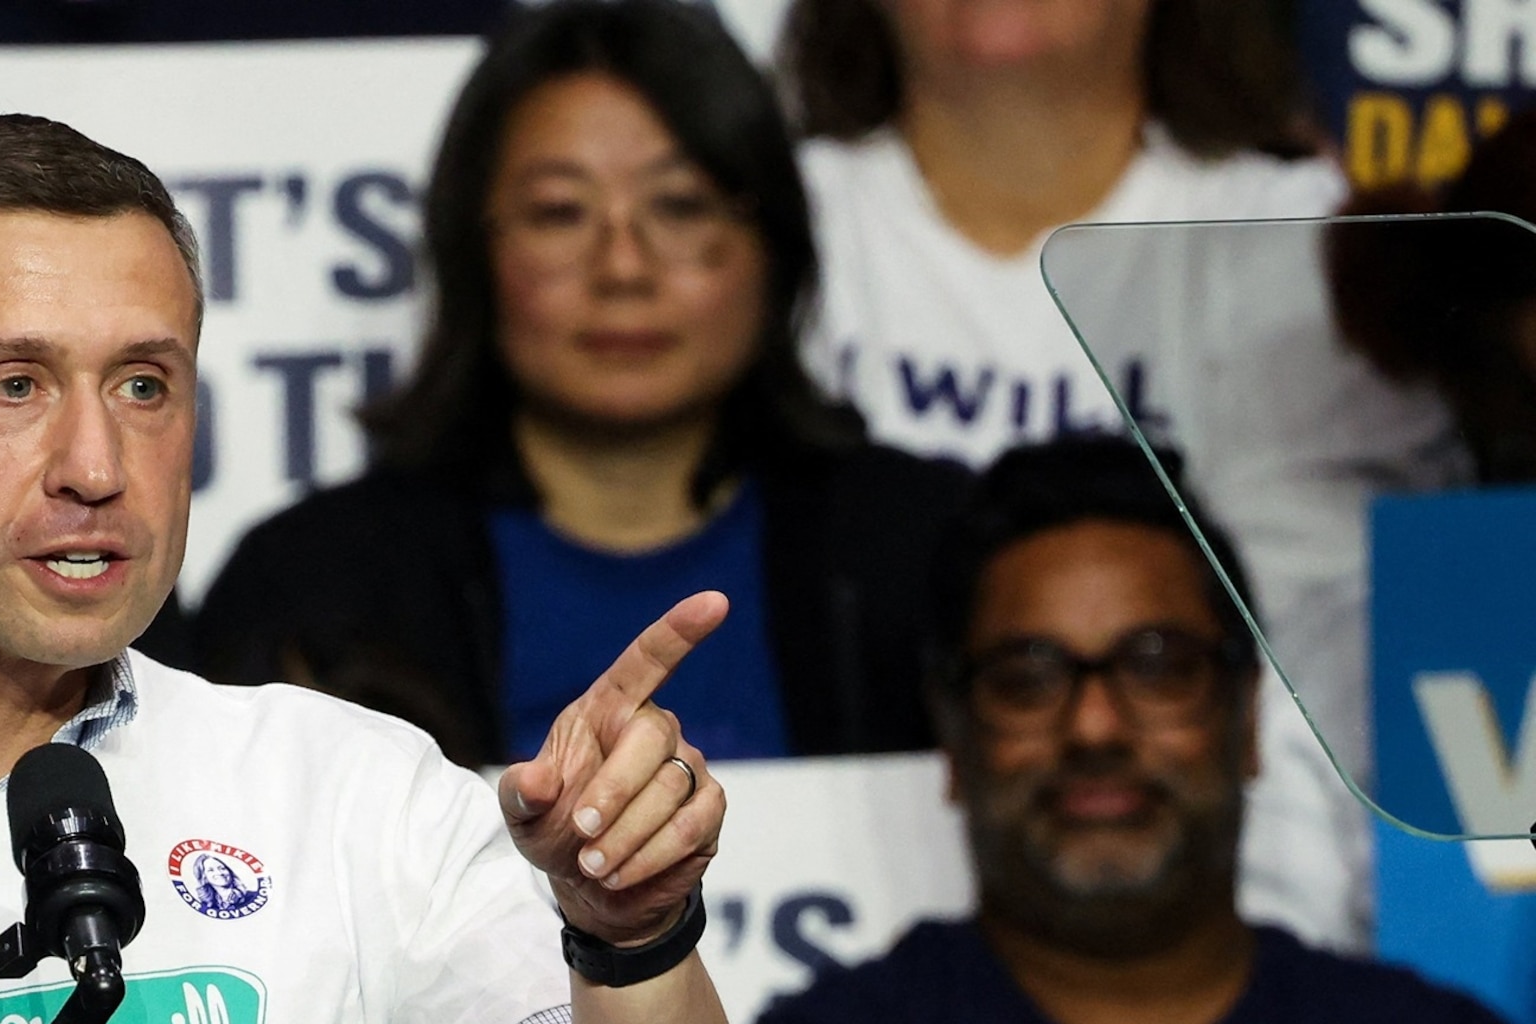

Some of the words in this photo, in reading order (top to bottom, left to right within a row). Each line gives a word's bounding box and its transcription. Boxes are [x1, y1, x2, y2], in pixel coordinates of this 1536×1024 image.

[171, 840, 203, 862] LIKE
[210, 842, 264, 873] MIKIE
[175, 884, 202, 910] FOR
